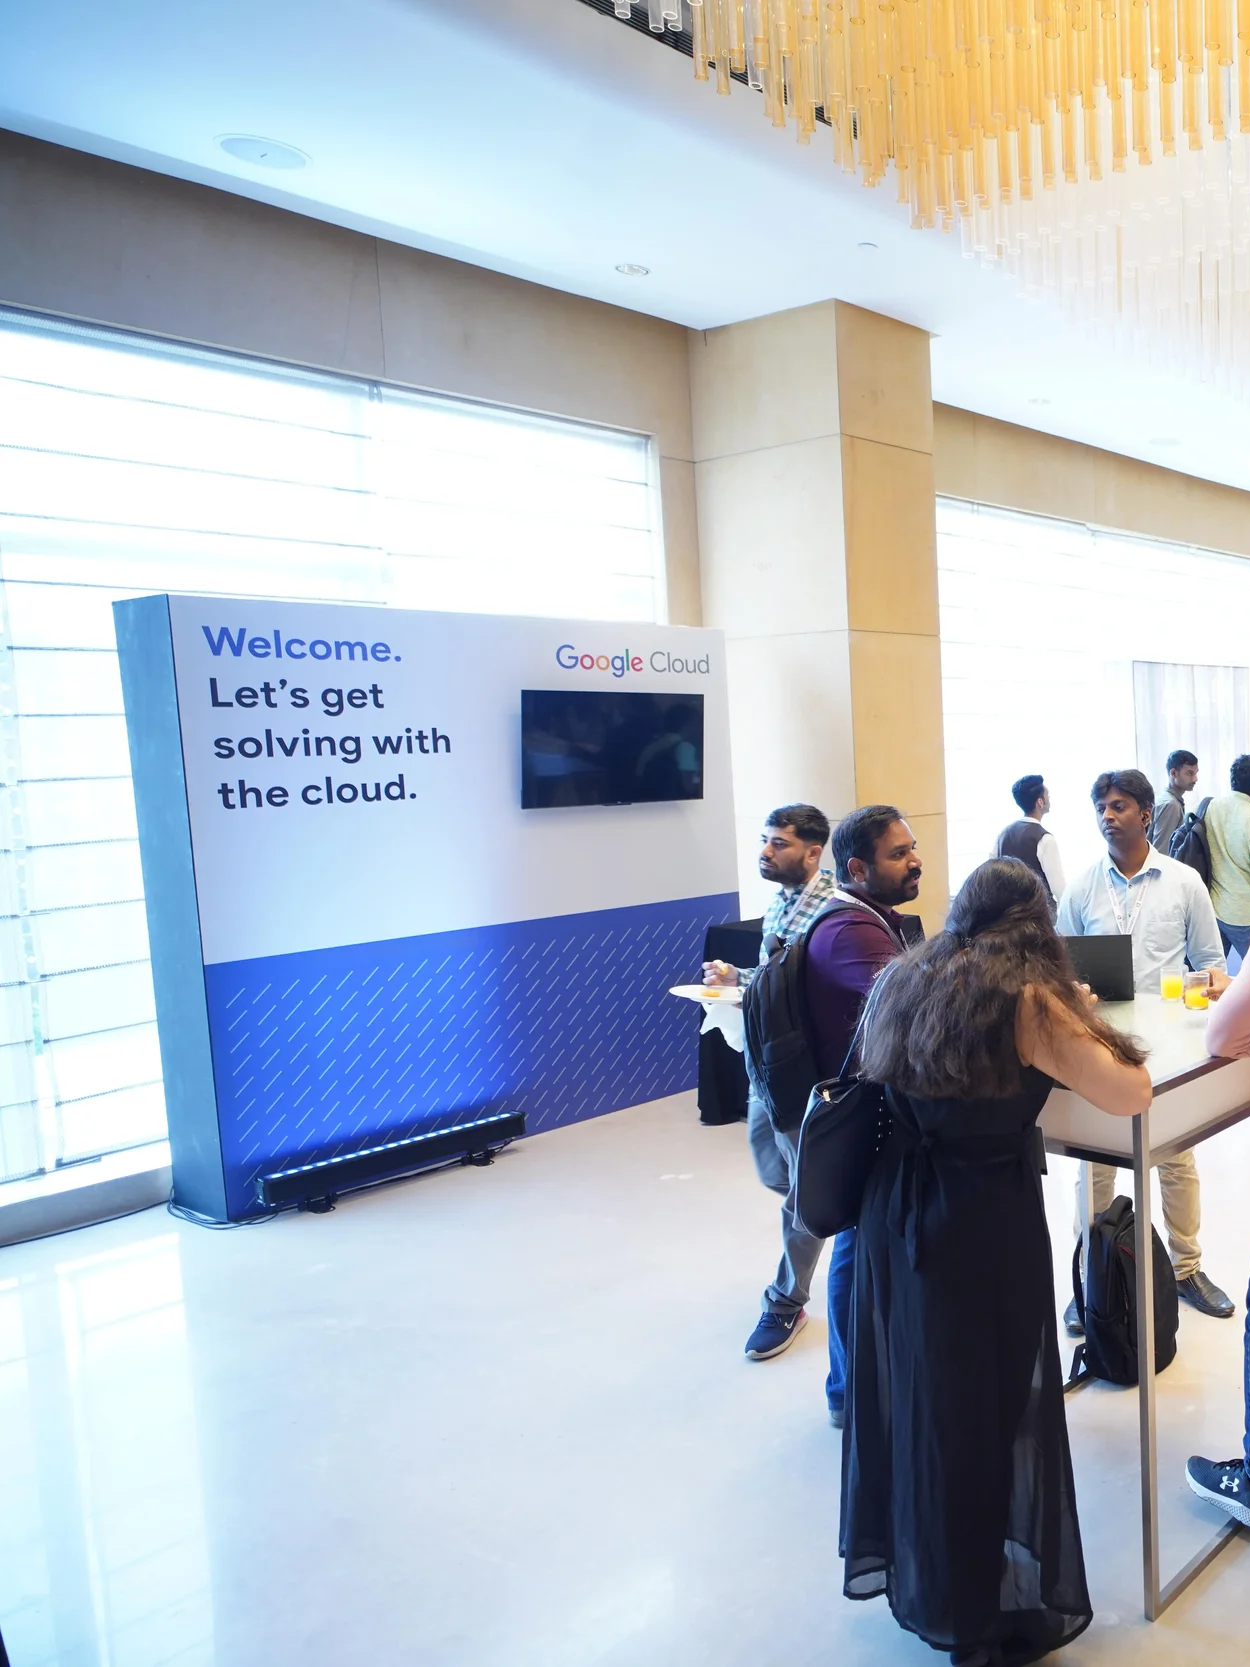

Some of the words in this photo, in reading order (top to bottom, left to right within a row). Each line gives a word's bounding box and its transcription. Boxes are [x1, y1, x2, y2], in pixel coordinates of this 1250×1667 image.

[202, 625, 402, 662] Welcome.
[556, 644, 644, 679] Google
[650, 651, 710, 675] Cloud
[210, 678, 310, 709] Let's
[321, 684, 385, 717] get
[214, 728, 362, 765] solving
[372, 727, 452, 755] with
[218, 779, 290, 810] the
[301, 773, 417, 806] cloud.
